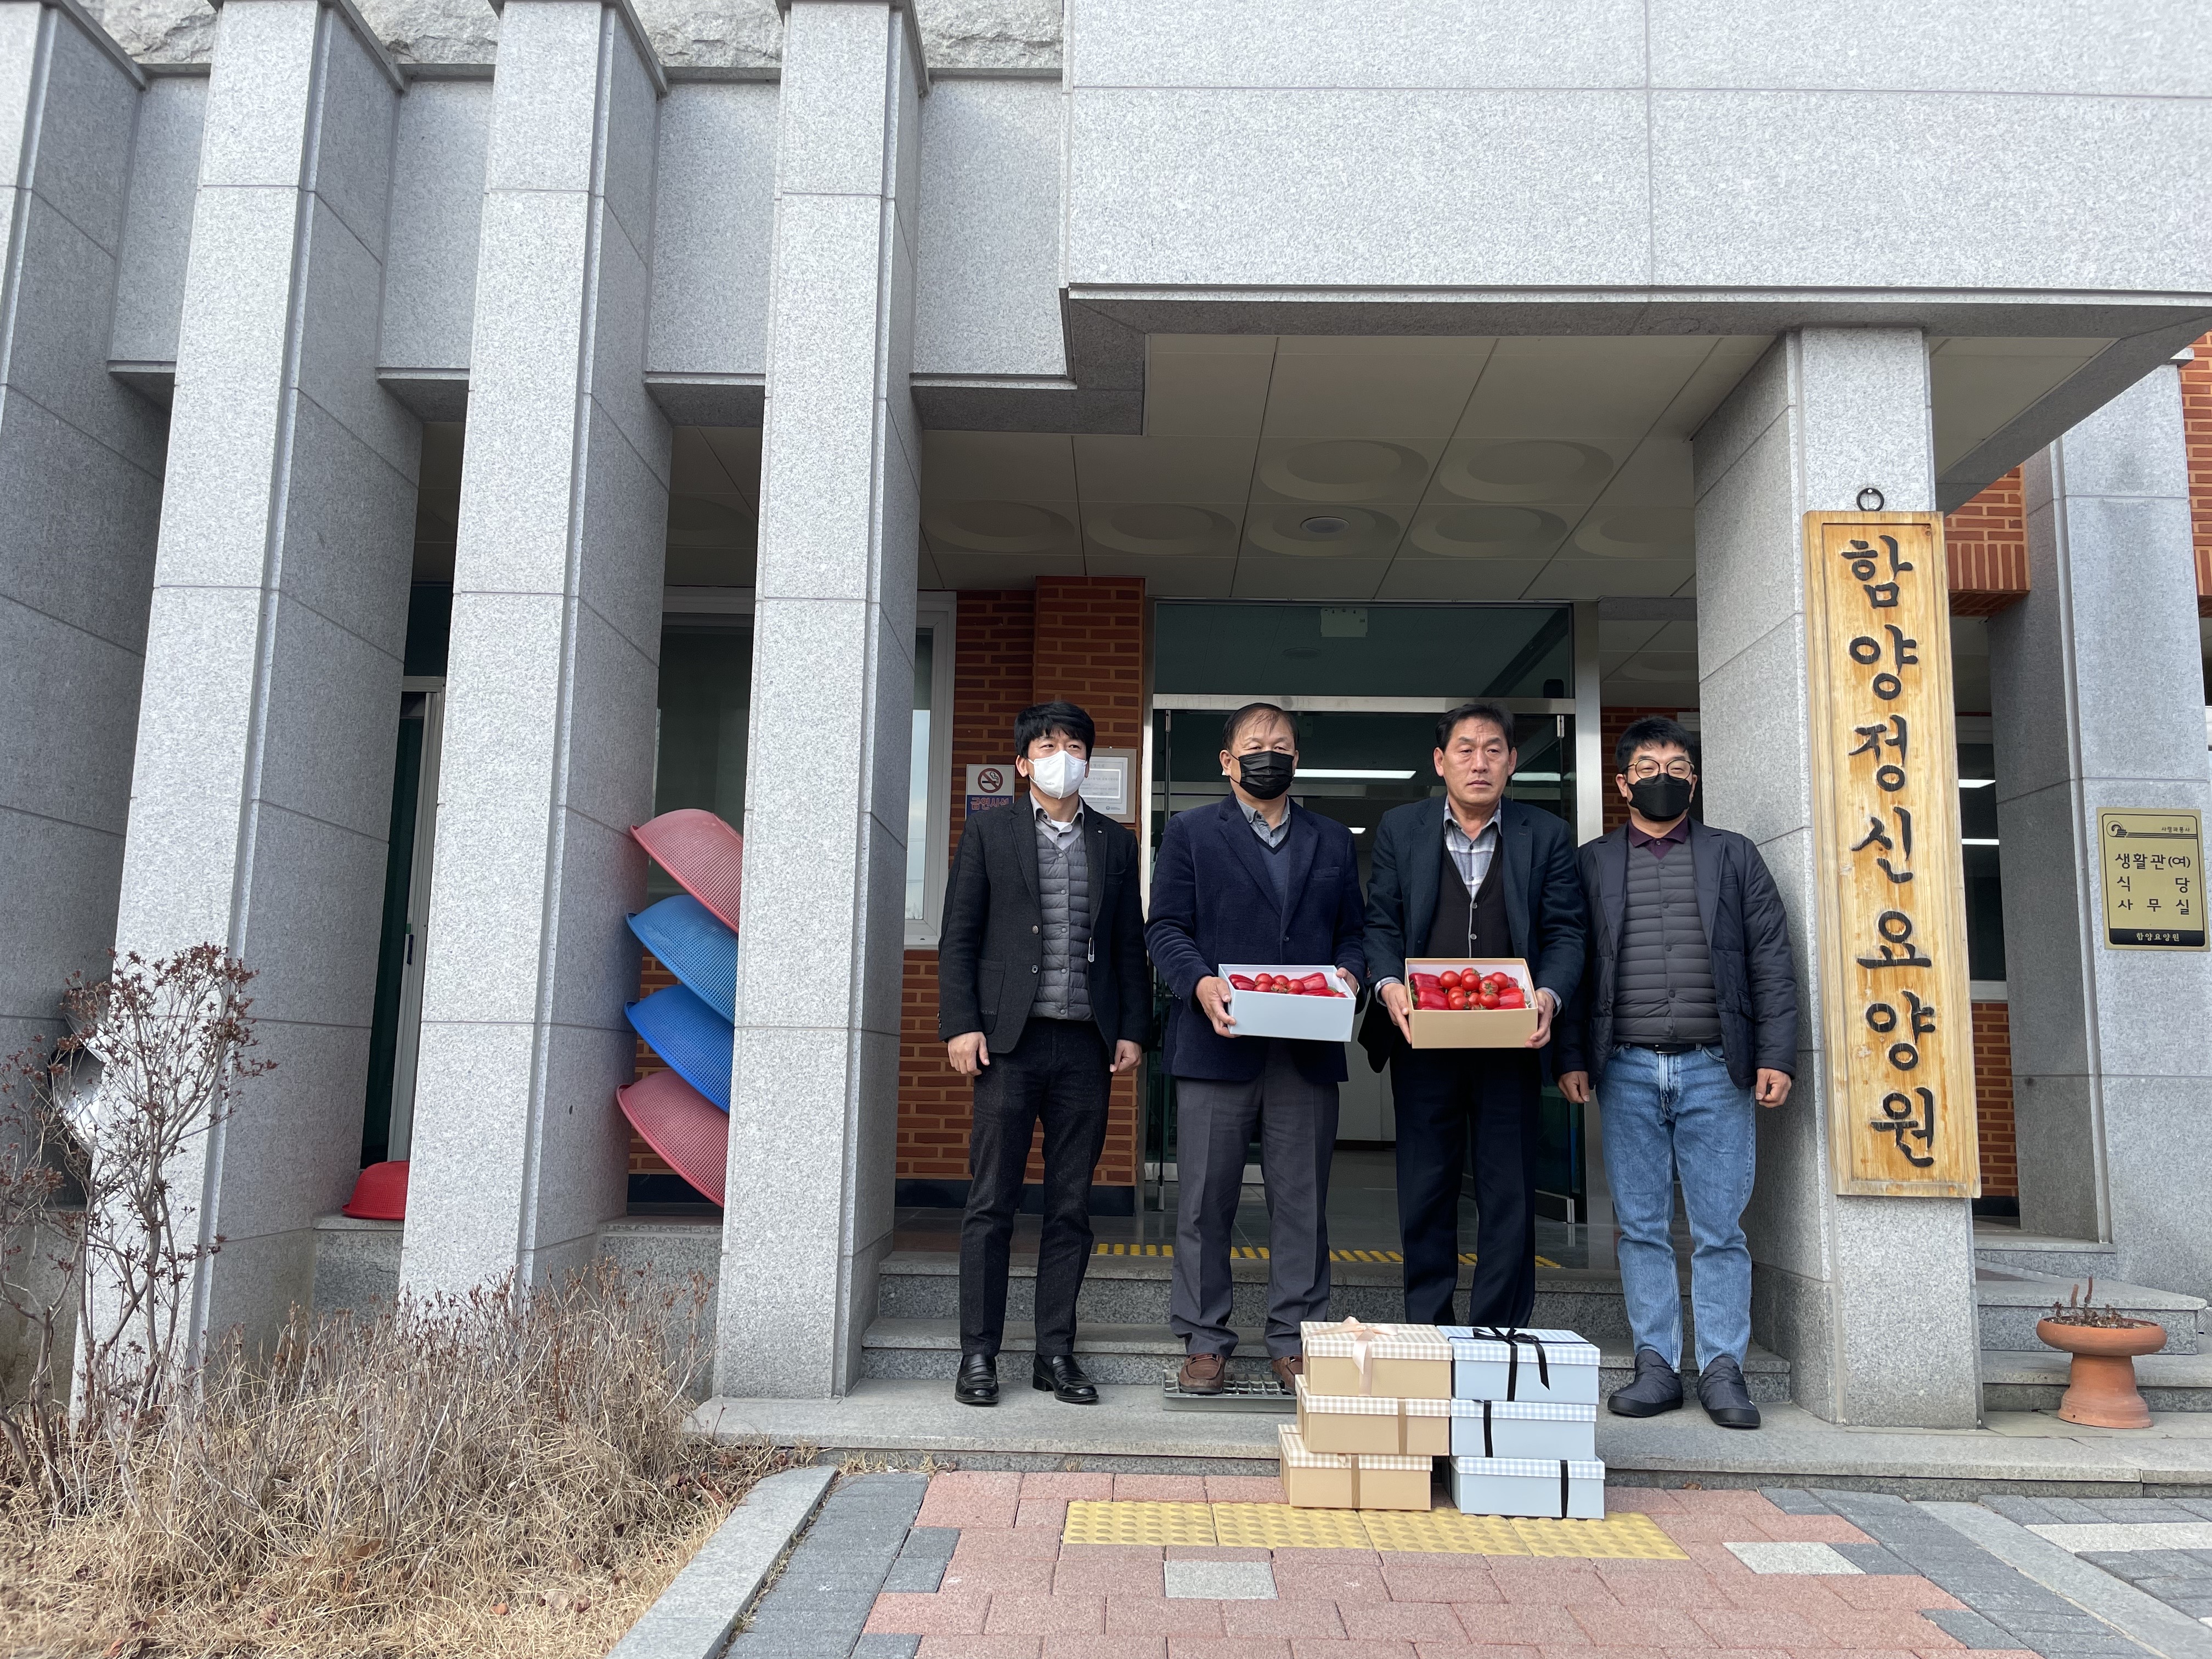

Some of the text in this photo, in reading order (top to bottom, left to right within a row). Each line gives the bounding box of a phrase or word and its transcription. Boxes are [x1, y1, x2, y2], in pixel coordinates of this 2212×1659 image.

[1841, 534, 1936, 1167] 함양정신요양원
[2115, 853, 2191, 870] 생활관(여)
[2136, 933, 2180, 942] 함양요양원
